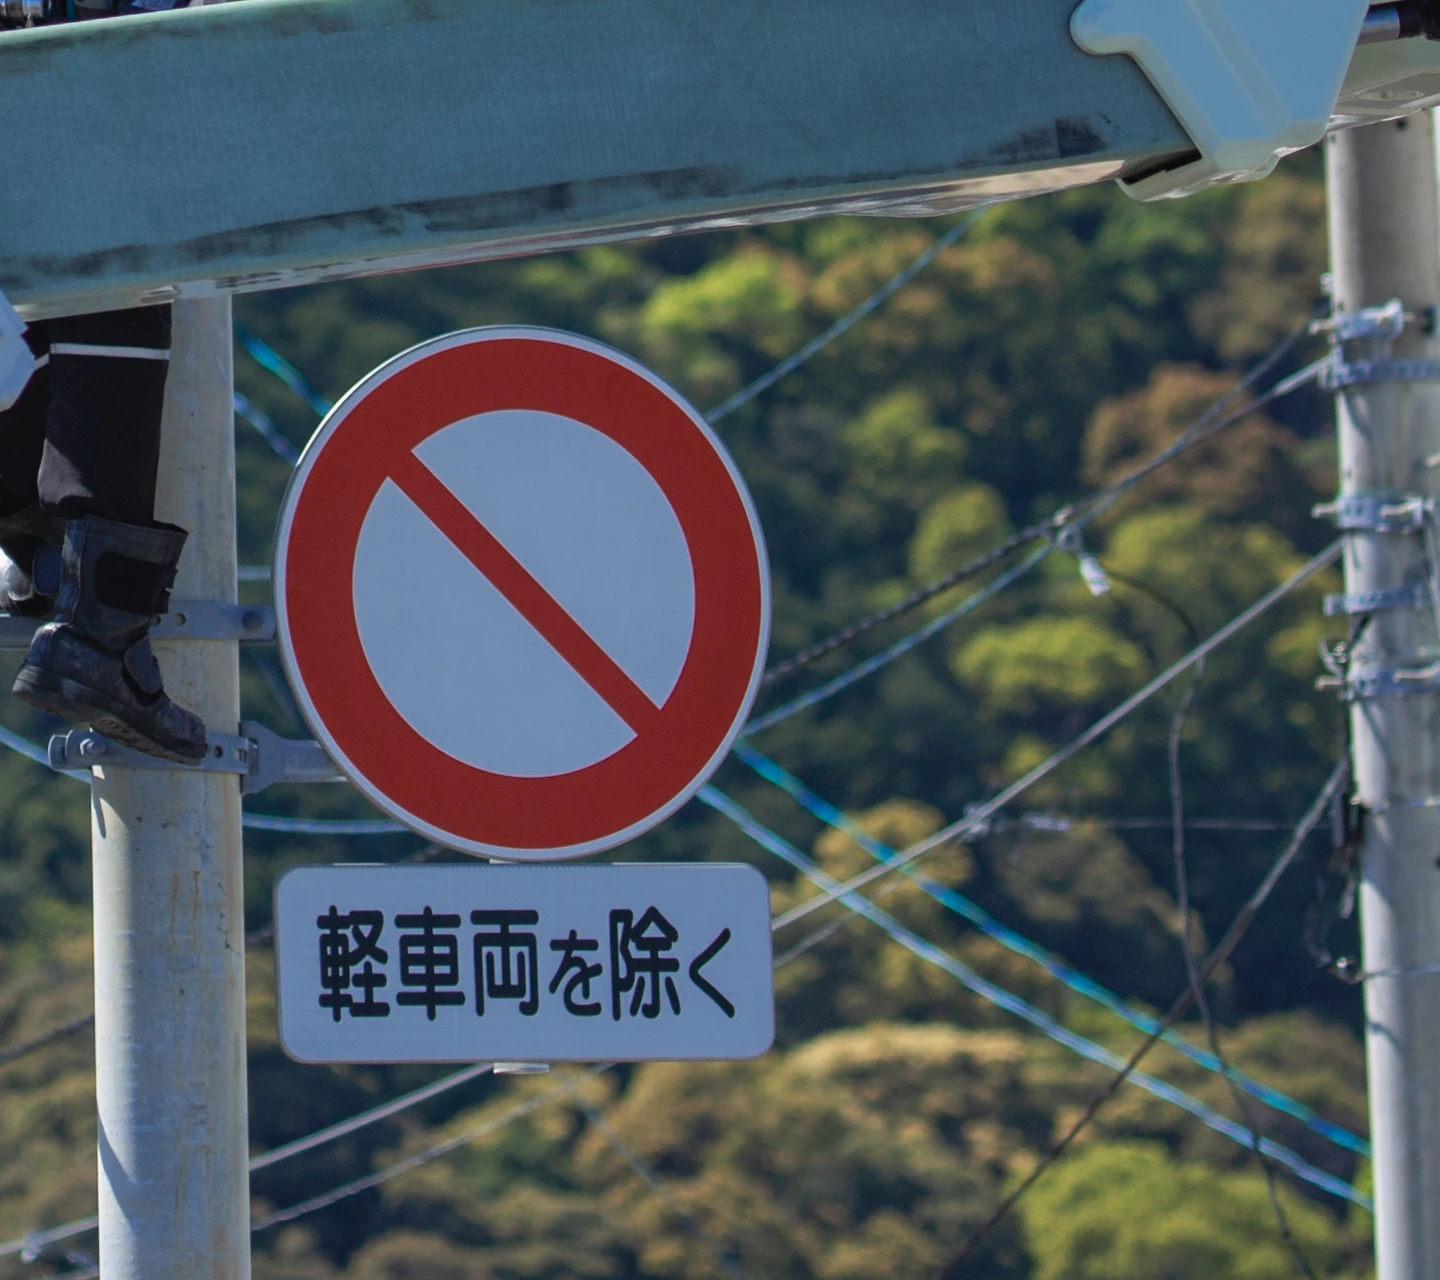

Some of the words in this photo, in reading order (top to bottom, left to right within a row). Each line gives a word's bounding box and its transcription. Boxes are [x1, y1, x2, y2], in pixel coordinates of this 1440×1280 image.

[315, 903, 736, 1024] 軽車両を除く
